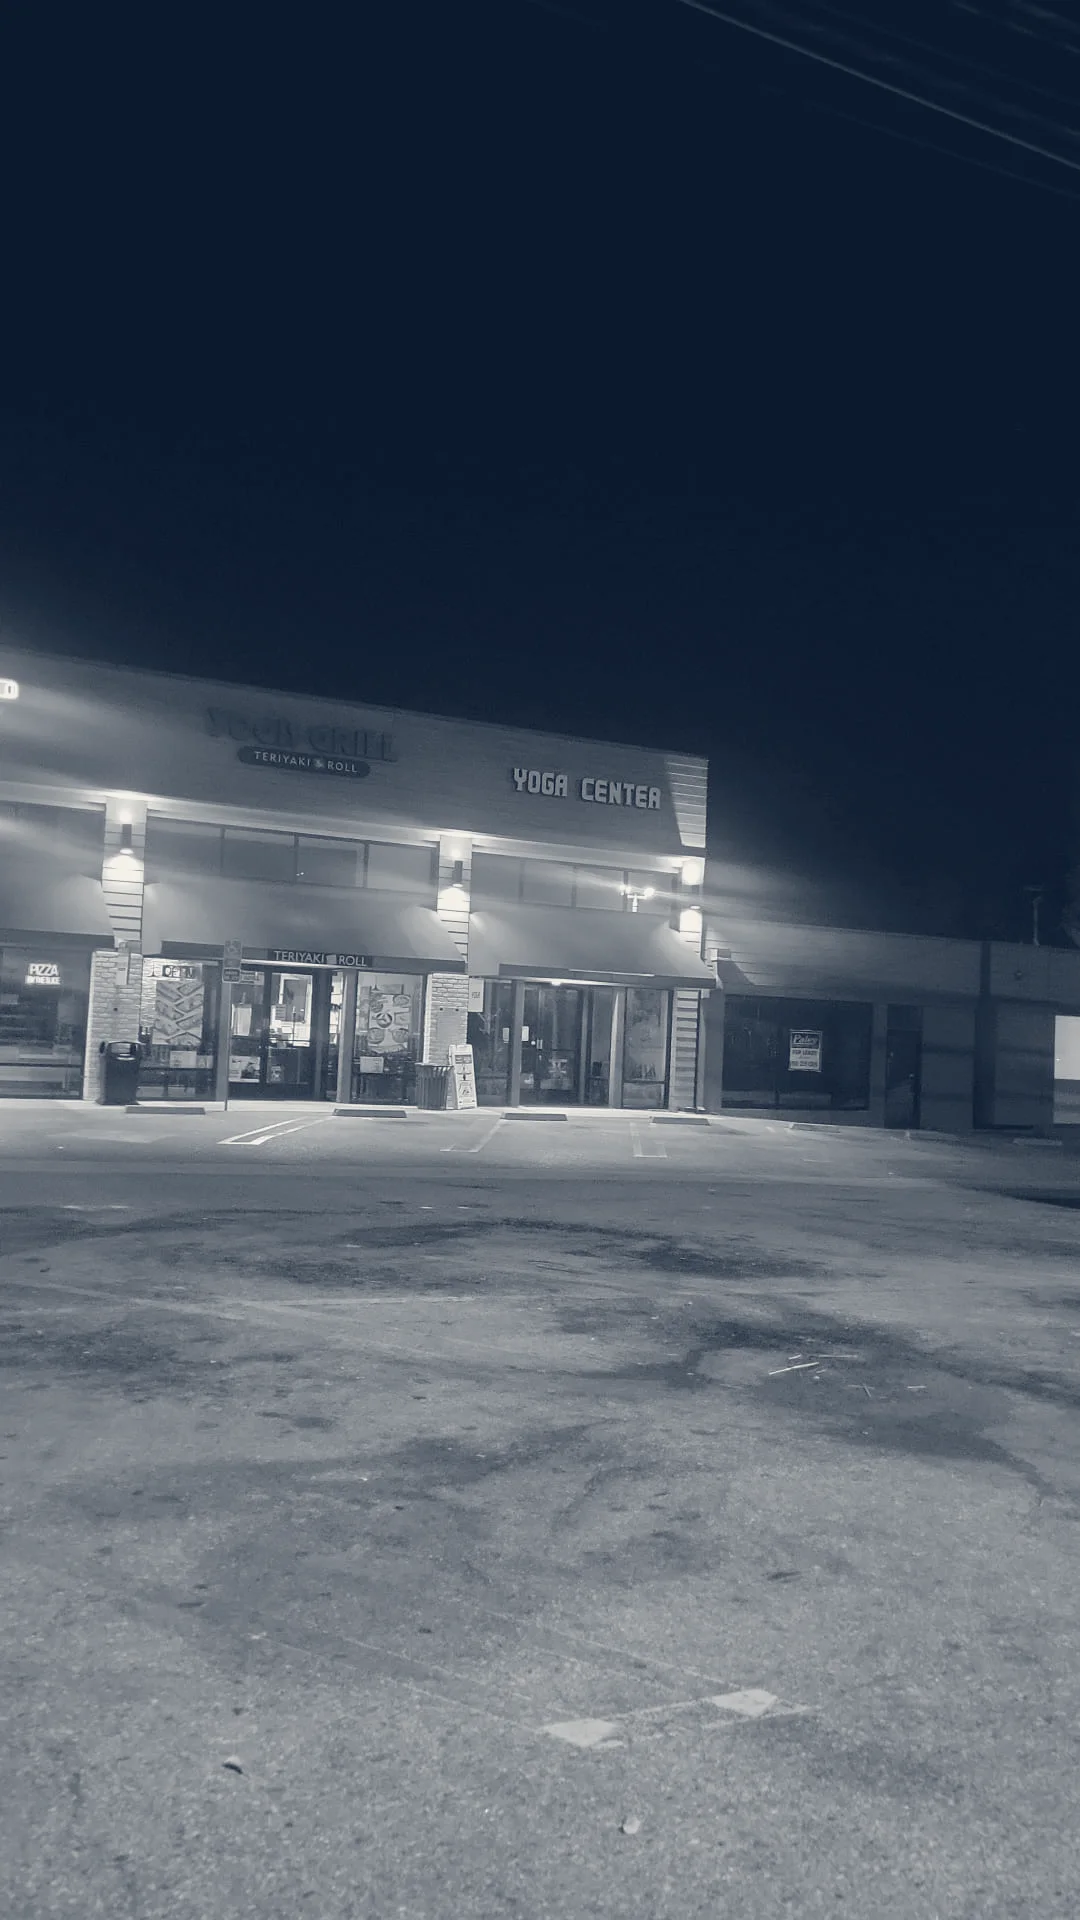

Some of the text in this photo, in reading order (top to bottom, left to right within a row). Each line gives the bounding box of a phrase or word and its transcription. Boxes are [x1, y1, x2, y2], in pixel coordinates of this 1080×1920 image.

[253, 750, 311, 767] TERIYAKI
[326, 760, 359, 774] ROLL
[513, 767, 662, 810] YOGA CENTER
[273, 950, 367, 967] TERIYAKI ROLL
[29, 963, 59, 976] PIZZA
